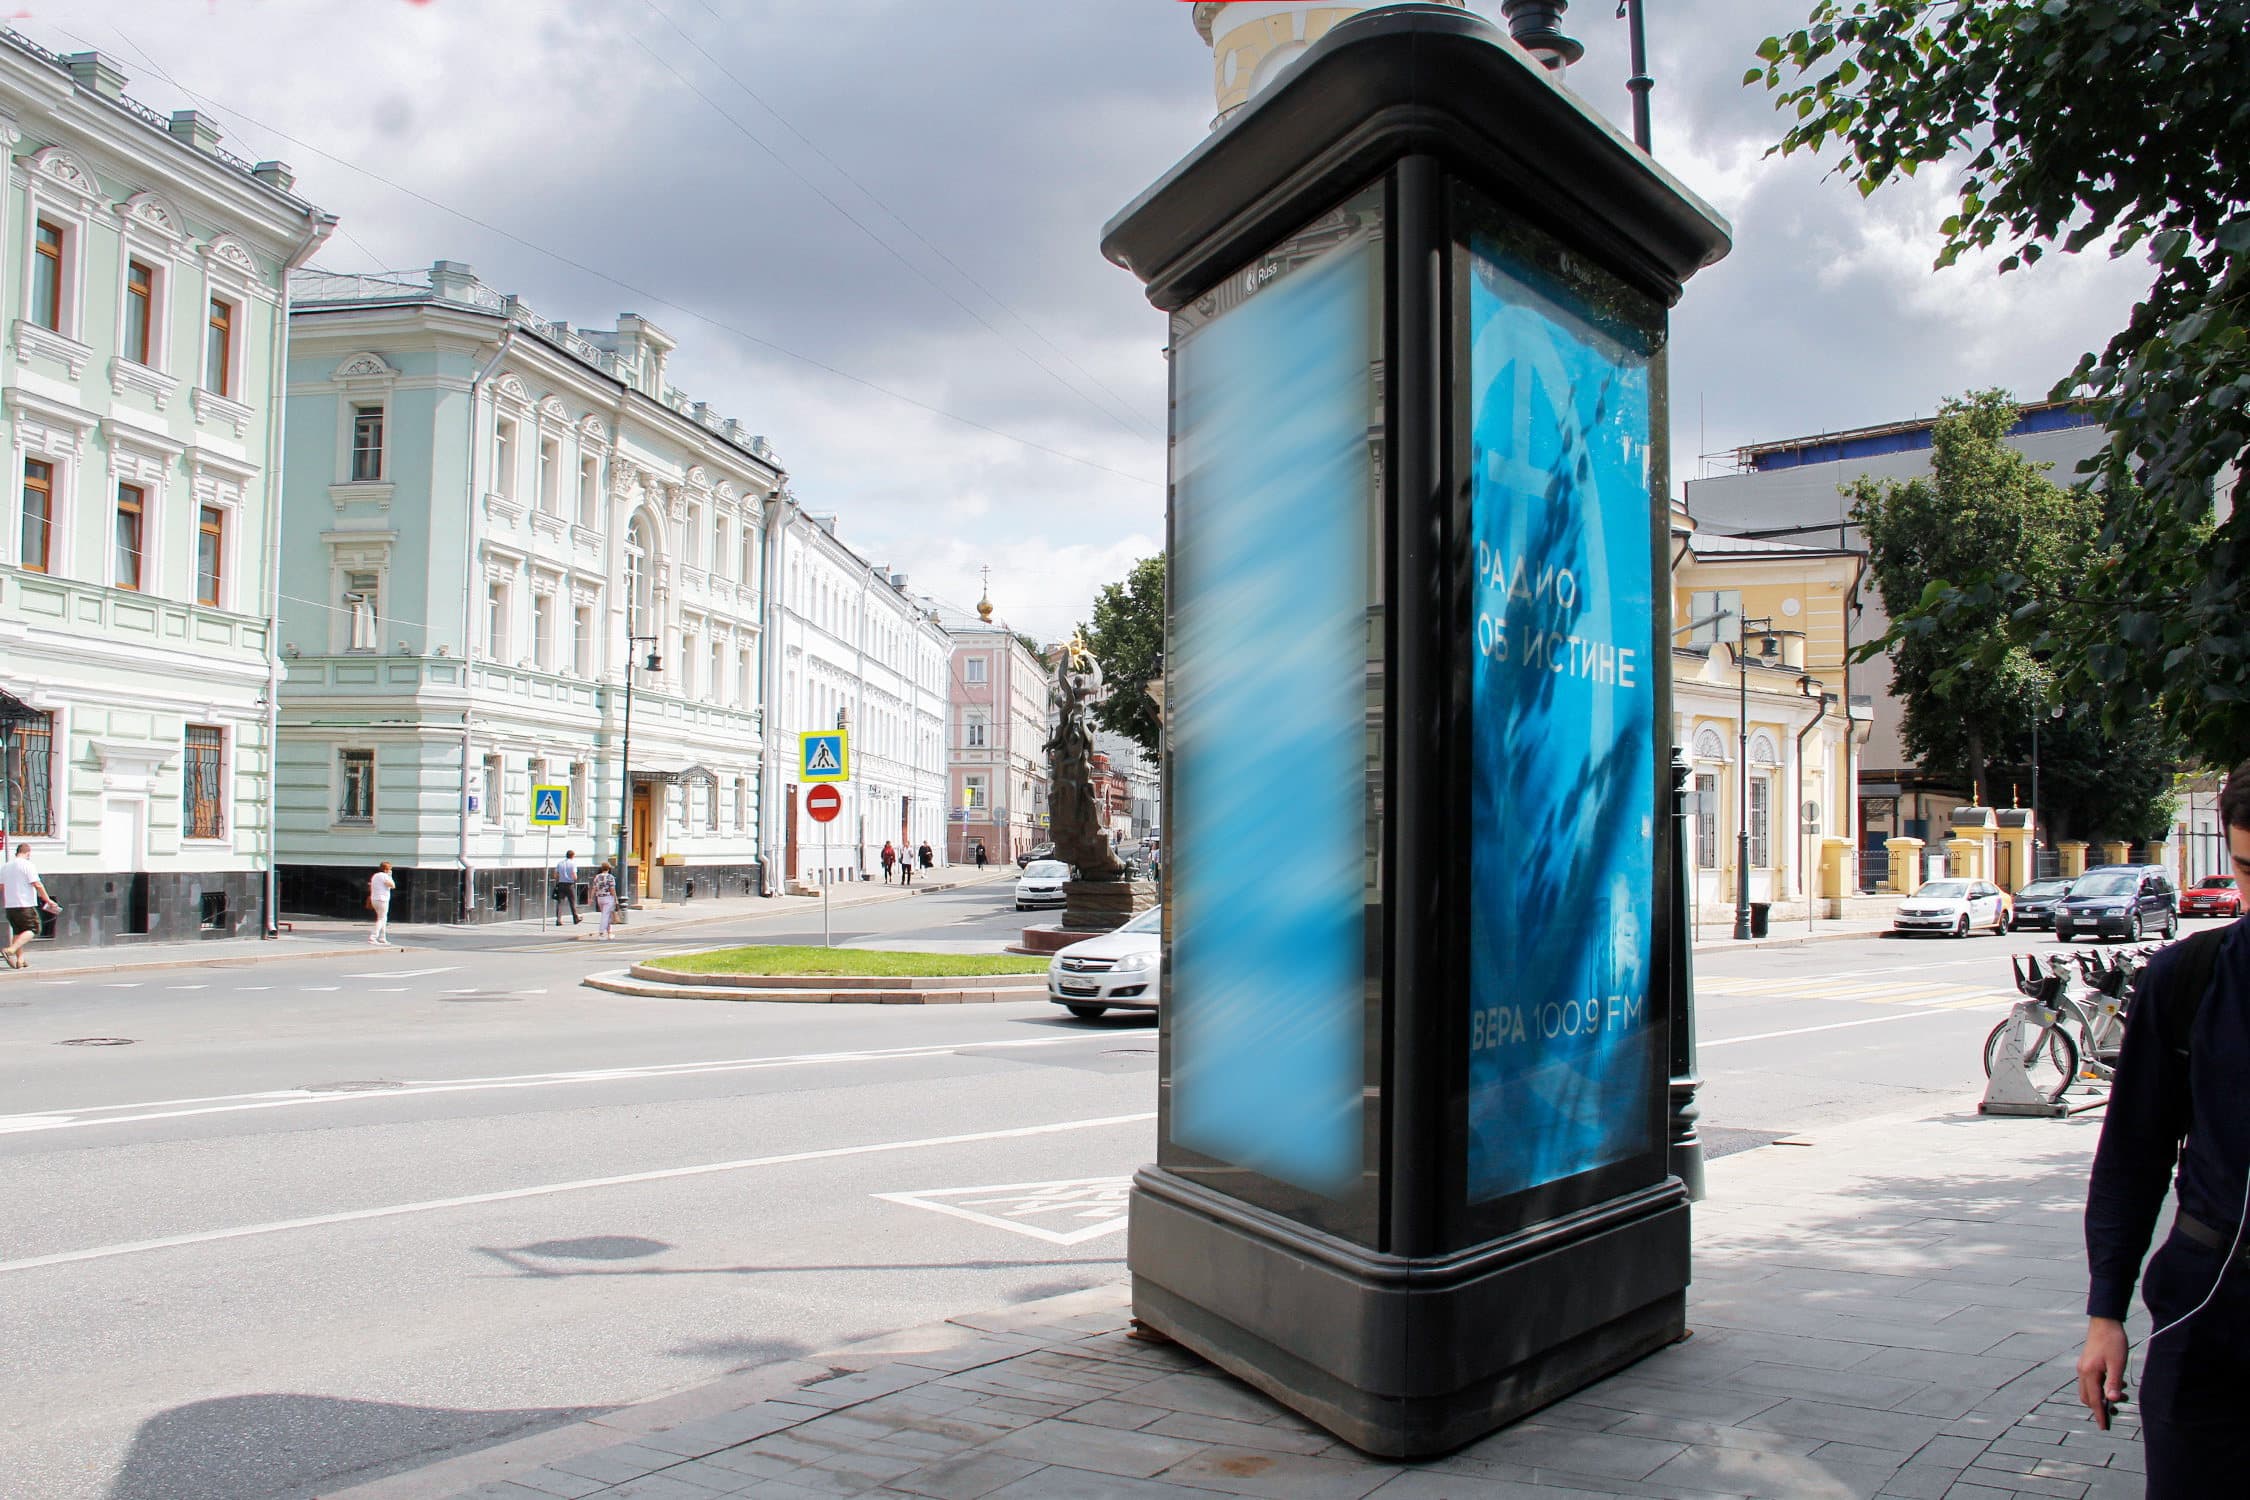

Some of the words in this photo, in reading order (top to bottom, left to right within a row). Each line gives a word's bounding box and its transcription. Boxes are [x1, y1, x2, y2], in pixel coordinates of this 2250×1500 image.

[1258, 262, 1278, 284] Russ
[1479, 539, 1577, 610] РАДИО
[1477, 611, 1509, 663] ОБ
[1522, 624, 1636, 689] ИСТИНЕ
[1473, 1004, 1526, 1051] ВЕРА
[1532, 997, 1601, 1041] 100.9
[1606, 993, 1644, 1033] FM
